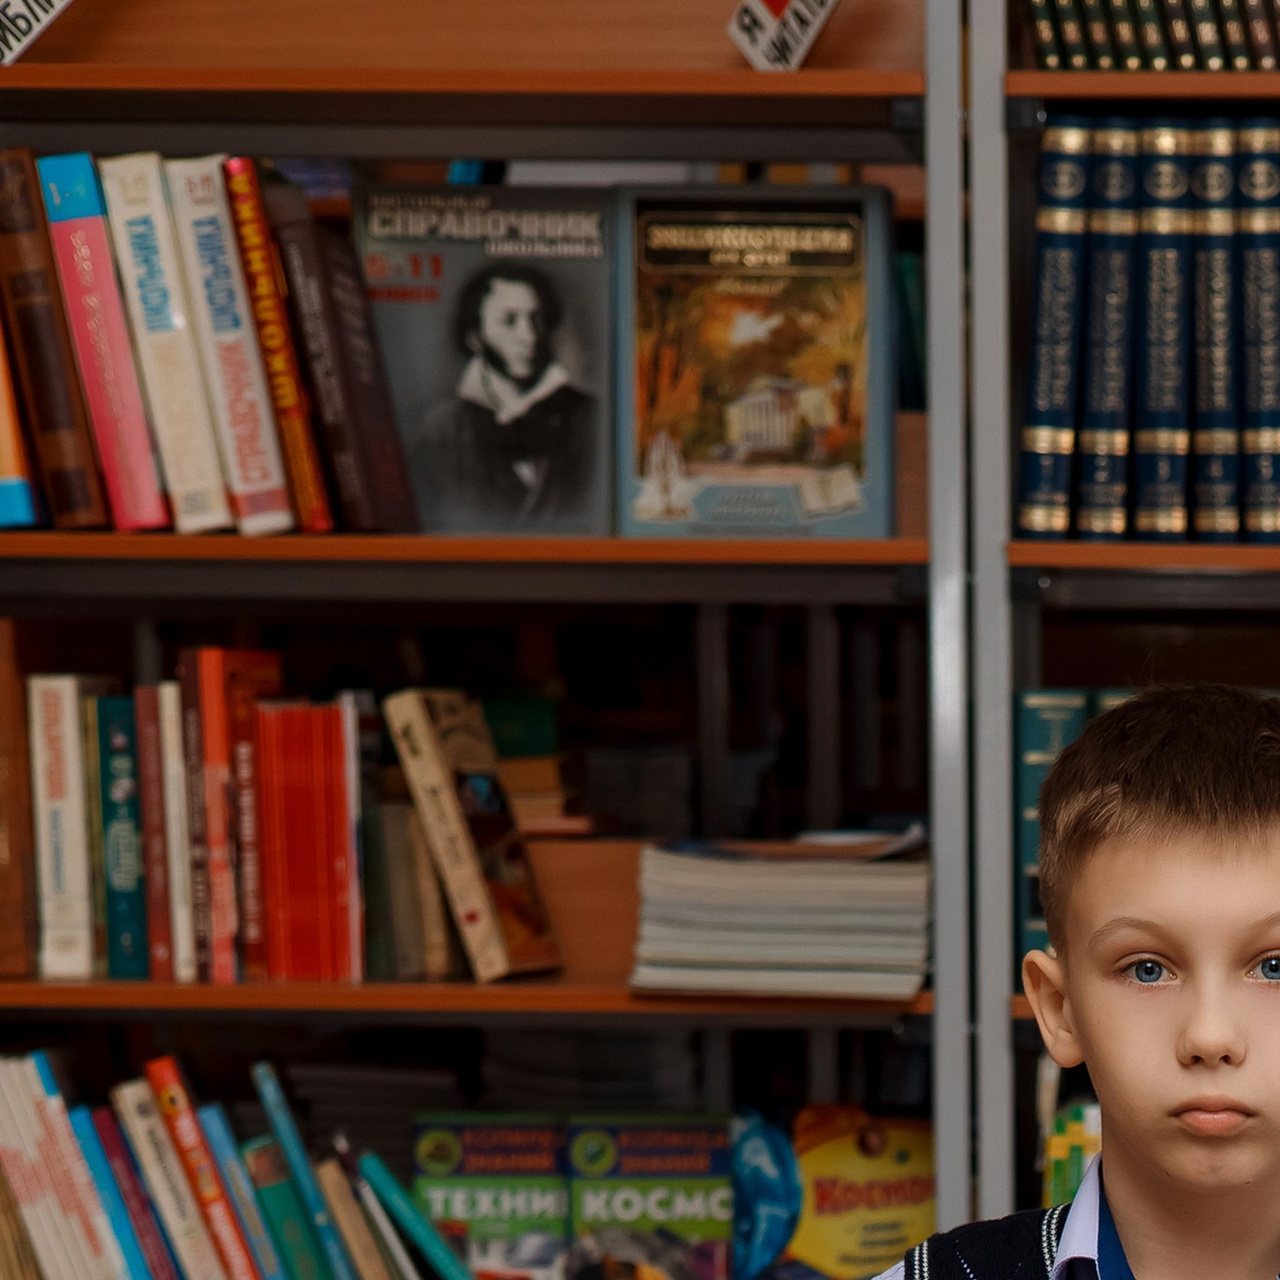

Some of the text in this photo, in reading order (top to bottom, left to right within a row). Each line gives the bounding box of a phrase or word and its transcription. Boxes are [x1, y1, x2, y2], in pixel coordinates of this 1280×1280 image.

[369, 210, 602, 240] СПРАВОЧНИК
[227, 172, 299, 410] ШКОЛЬНИКА
[428, 1187, 568, 1220] ТЕХНИ
